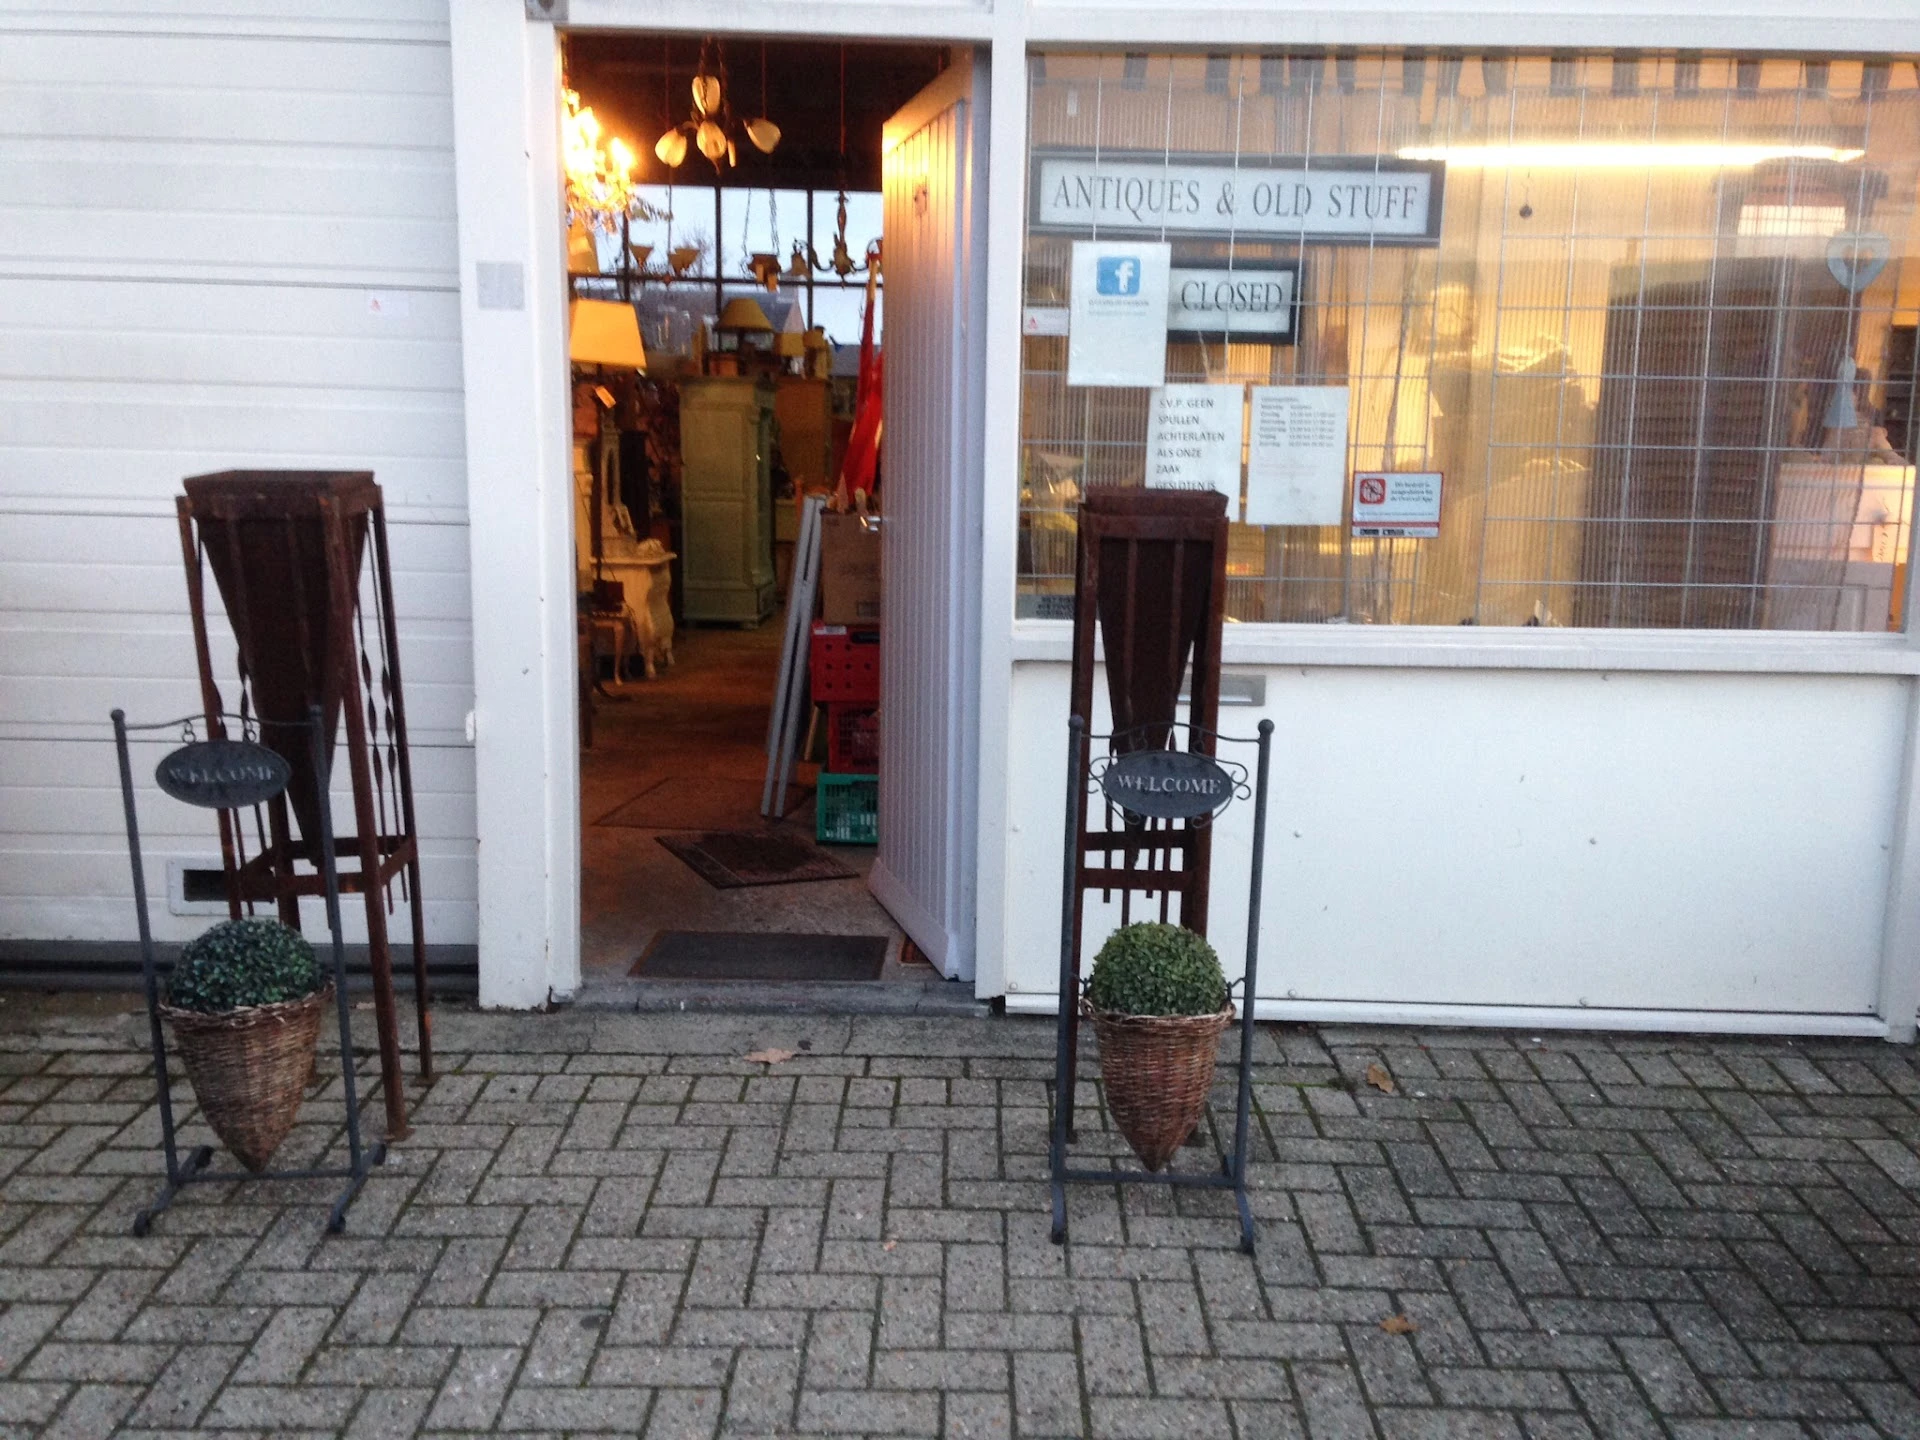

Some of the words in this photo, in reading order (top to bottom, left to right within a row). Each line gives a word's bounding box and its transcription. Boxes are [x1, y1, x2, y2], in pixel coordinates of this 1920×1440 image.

[1053, 174, 1200, 220] ANTIQUES
[1216, 182, 1236, 215] &
[1253, 182, 1312, 217] OLD
[1328, 183, 1418, 219] STUFF
[1181, 280, 1282, 312] CLOSED
[1187, 398, 1214, 408] GEEN
[1158, 415, 1200, 425] SPULLEN
[1156, 432, 1225, 442] ACHTERLATEN
[1156, 448, 1174, 458] ALS
[1176, 449, 1203, 458] ONZE
[1155, 464, 1181, 474] ZAAK
[1118, 775, 1221, 794] WELCOME
